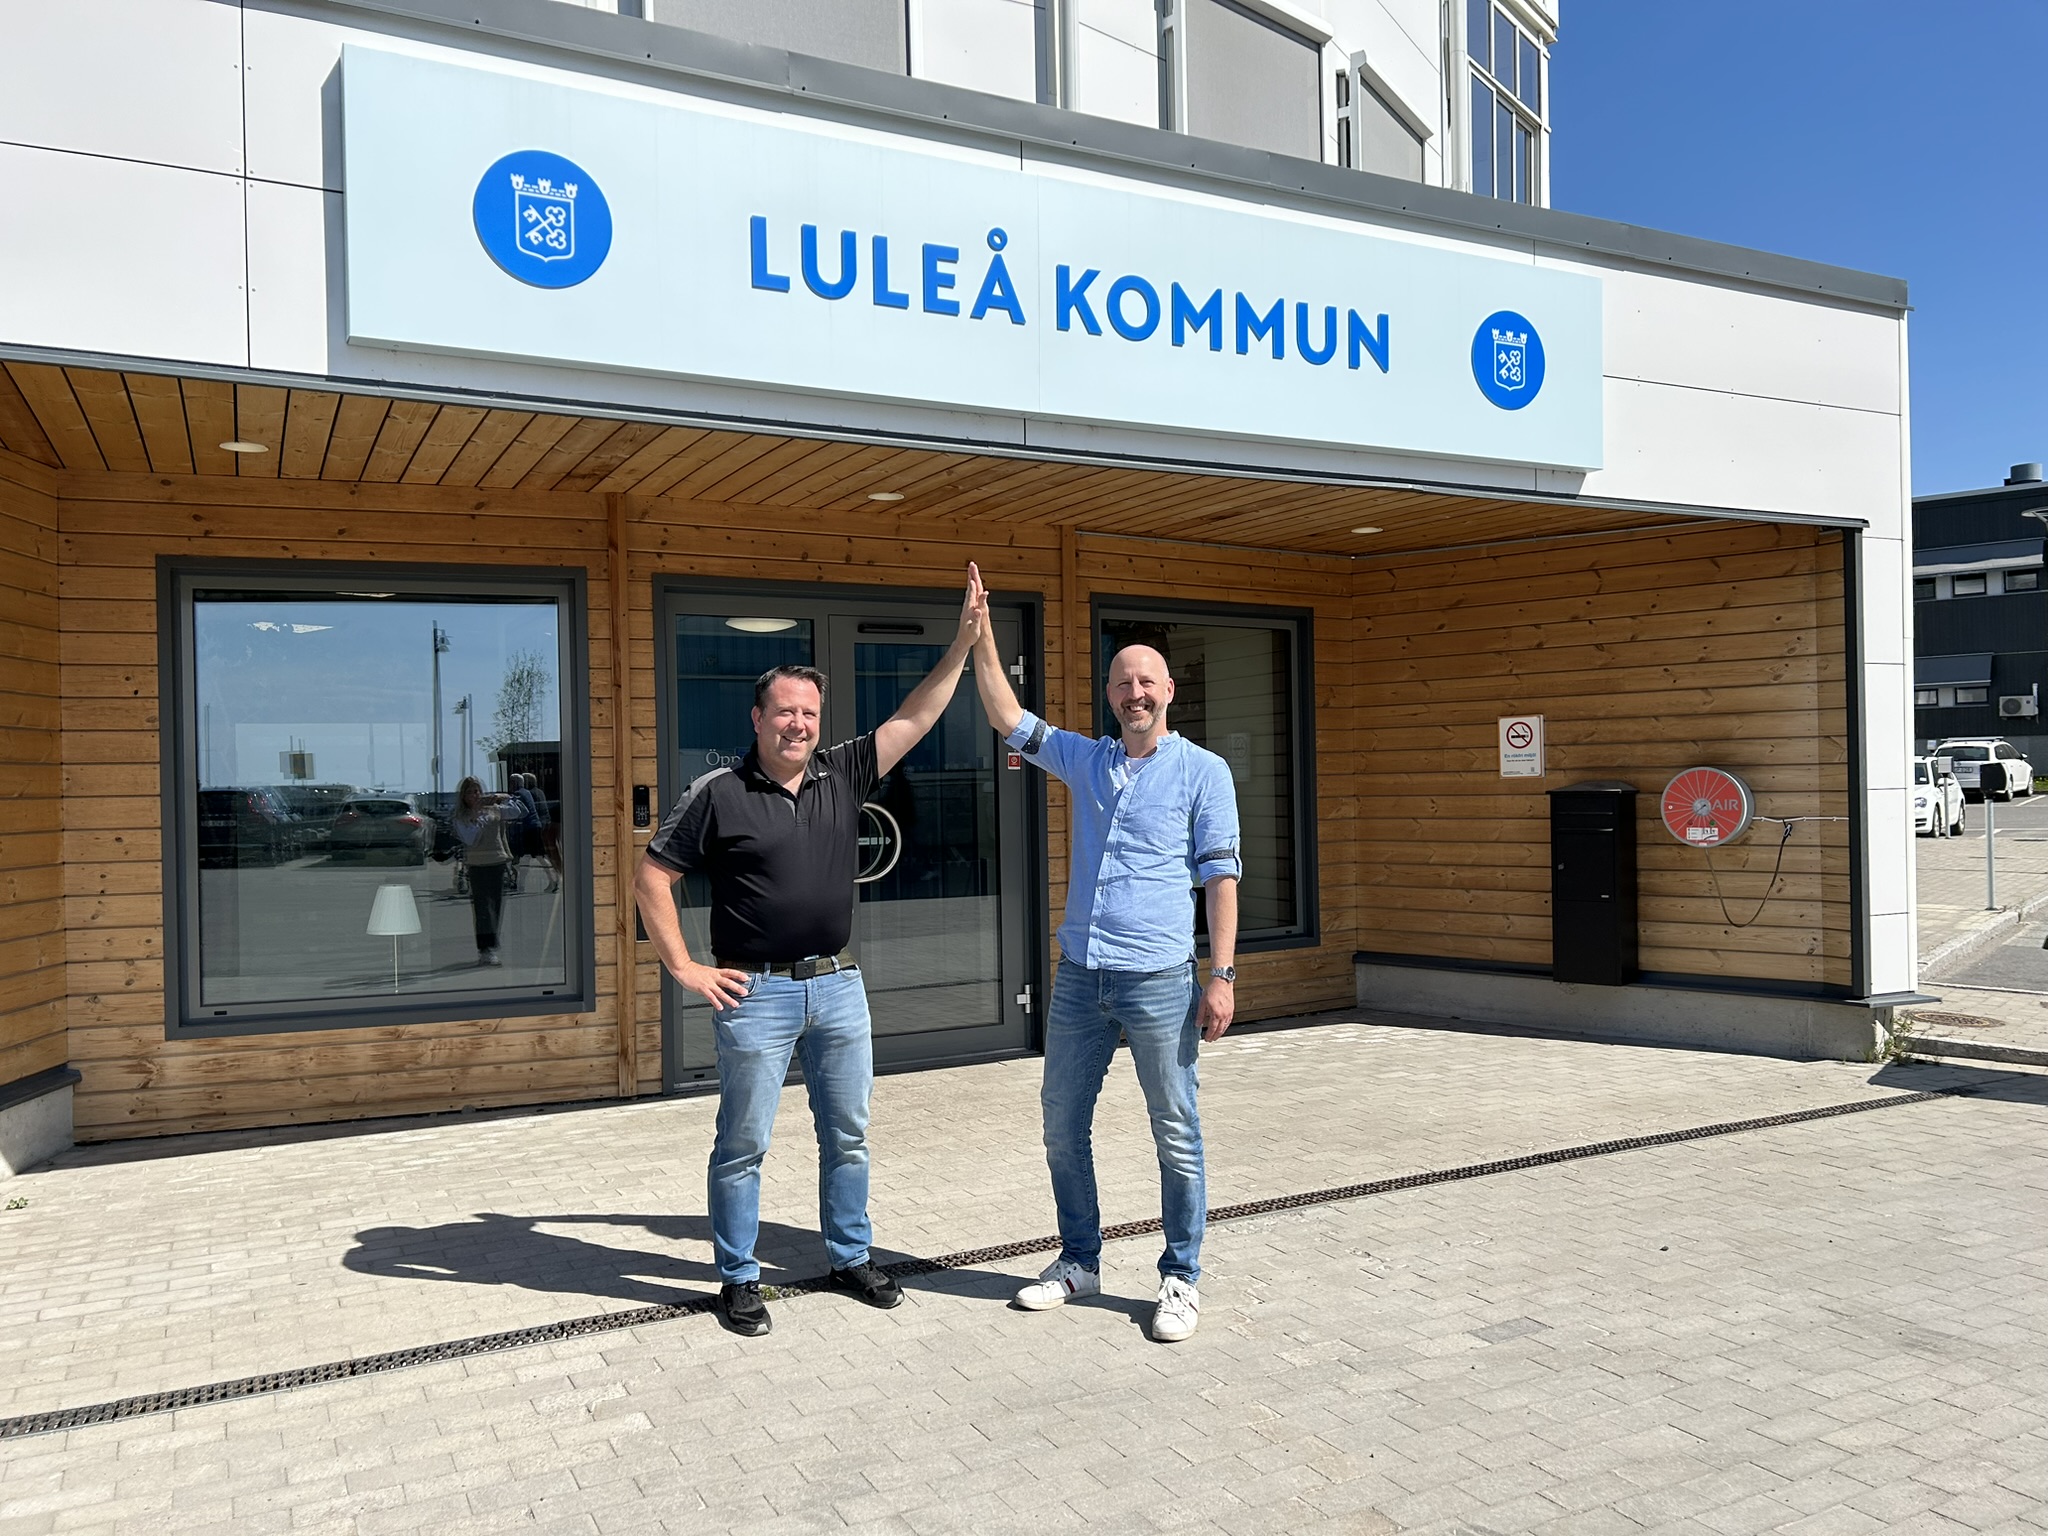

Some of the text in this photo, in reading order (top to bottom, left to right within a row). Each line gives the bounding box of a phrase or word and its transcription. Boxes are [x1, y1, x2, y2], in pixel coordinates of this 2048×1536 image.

[749, 214, 1390, 374] LULEÅ KOMMUN
[1712, 799, 1738, 811] AIR
